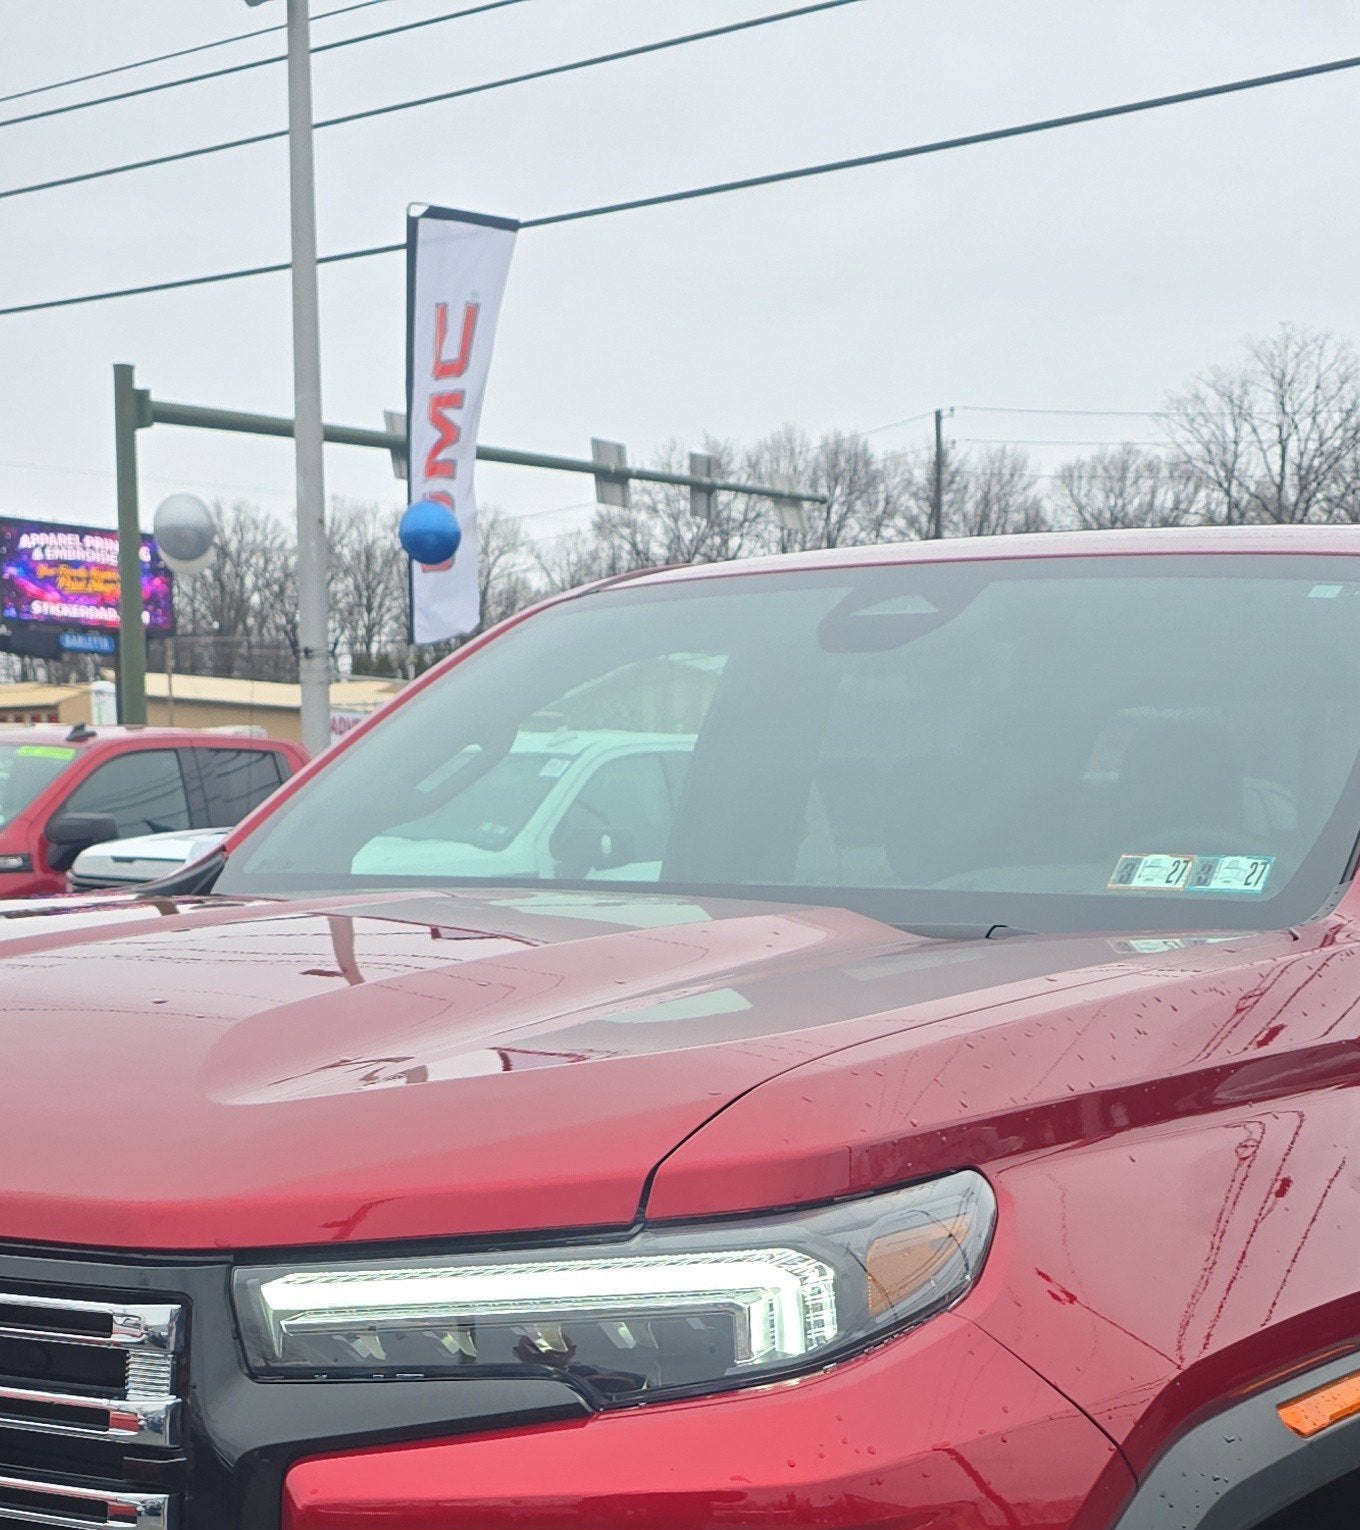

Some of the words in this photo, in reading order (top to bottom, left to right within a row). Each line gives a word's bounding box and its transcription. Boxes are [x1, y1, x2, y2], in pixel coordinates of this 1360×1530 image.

[18, 532, 83, 550] APPAREL
[1164, 859, 1190, 886] 27
[1243, 861, 1269, 888] 27
